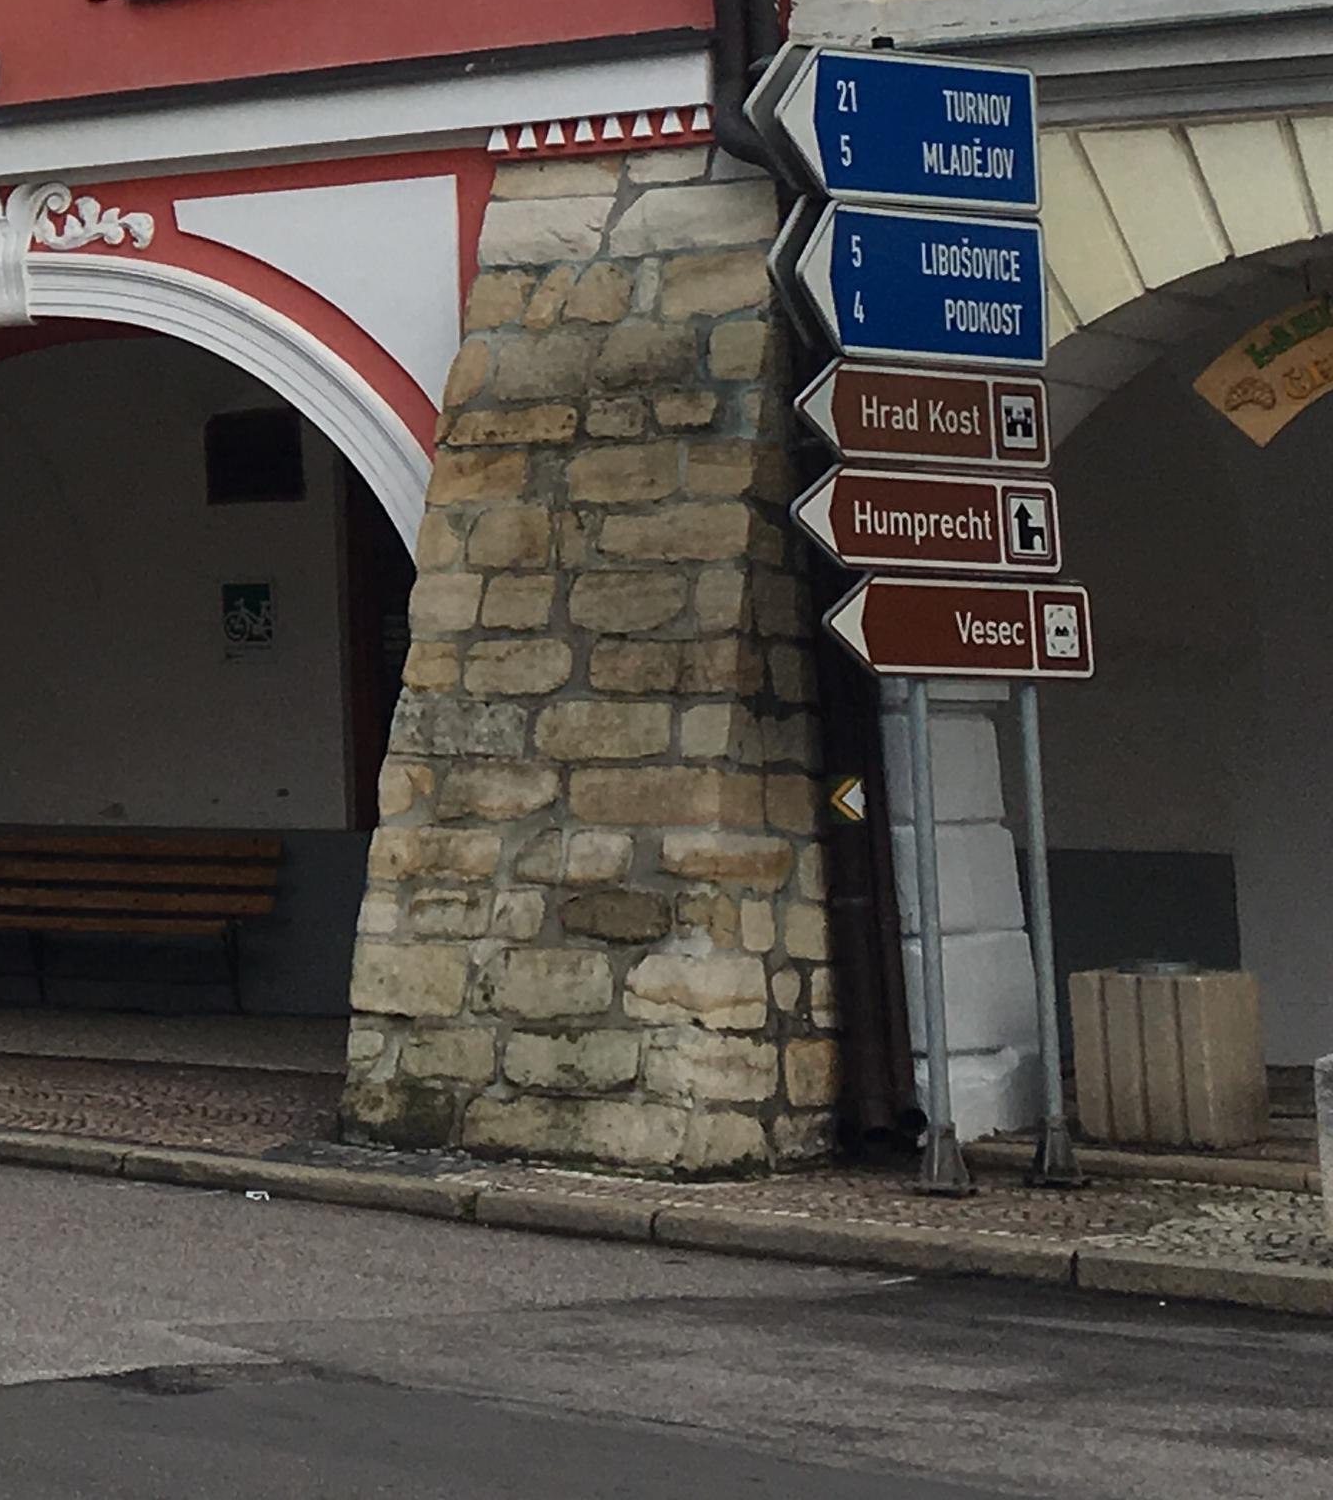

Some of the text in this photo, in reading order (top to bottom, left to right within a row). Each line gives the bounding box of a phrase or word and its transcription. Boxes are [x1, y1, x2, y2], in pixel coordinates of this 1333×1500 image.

[836, 80, 1011, 127] 21 TURNOV
[840, 134, 1014, 180] 5 MLADĚJOV
[851, 235, 1021, 282] 5 LIBOŠOVICE
[853, 291, 1023, 336] 4 PODKOST
[861, 394, 981, 435] Hrad Kost
[853, 500, 993, 545] Humprecht
[955, 611, 1025, 646] Vesec
